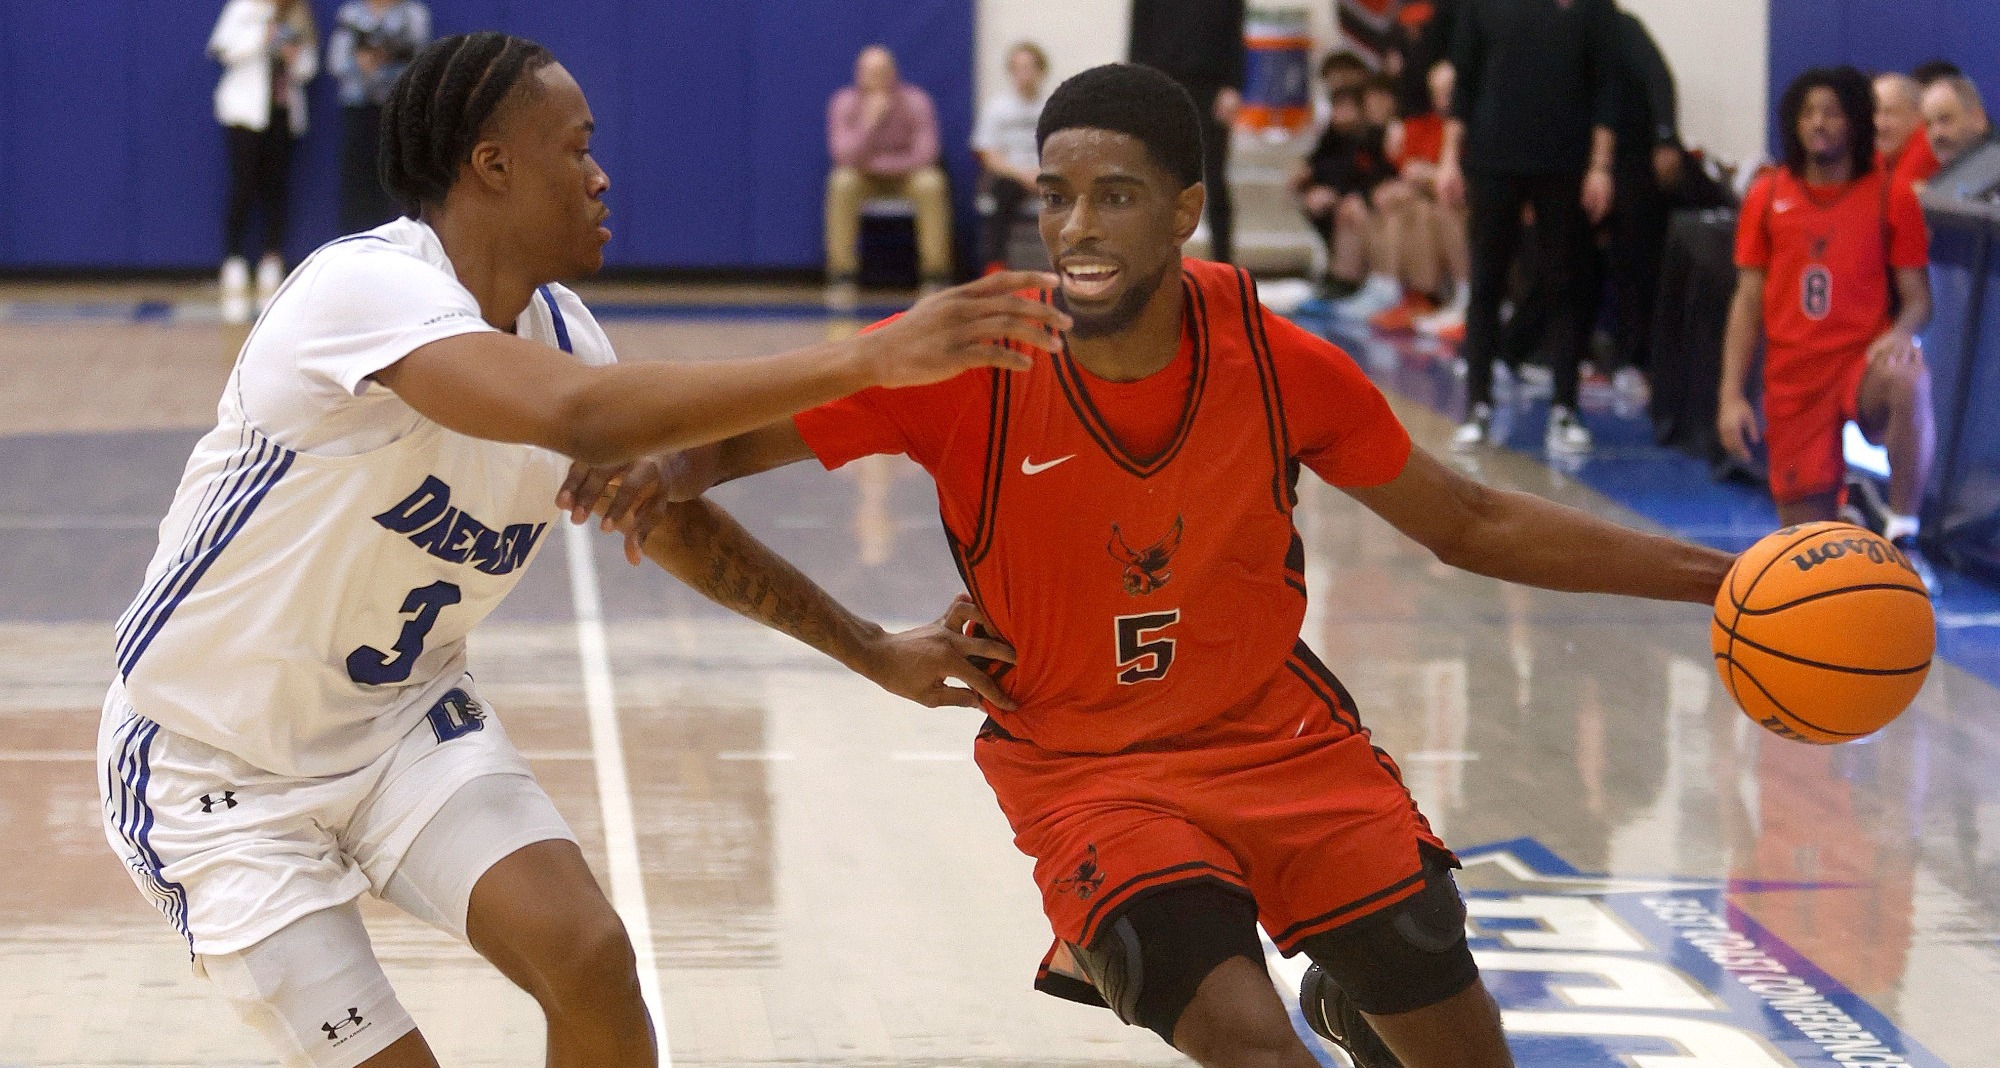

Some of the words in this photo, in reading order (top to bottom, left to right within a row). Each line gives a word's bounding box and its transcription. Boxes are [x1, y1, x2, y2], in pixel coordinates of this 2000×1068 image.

[1799, 263, 1833, 321] 8
[371, 474, 548, 576] DAEMEN
[346, 580, 461, 685] 3
[1114, 607, 1180, 686] 5
[1680, 928, 1789, 968] COAST
